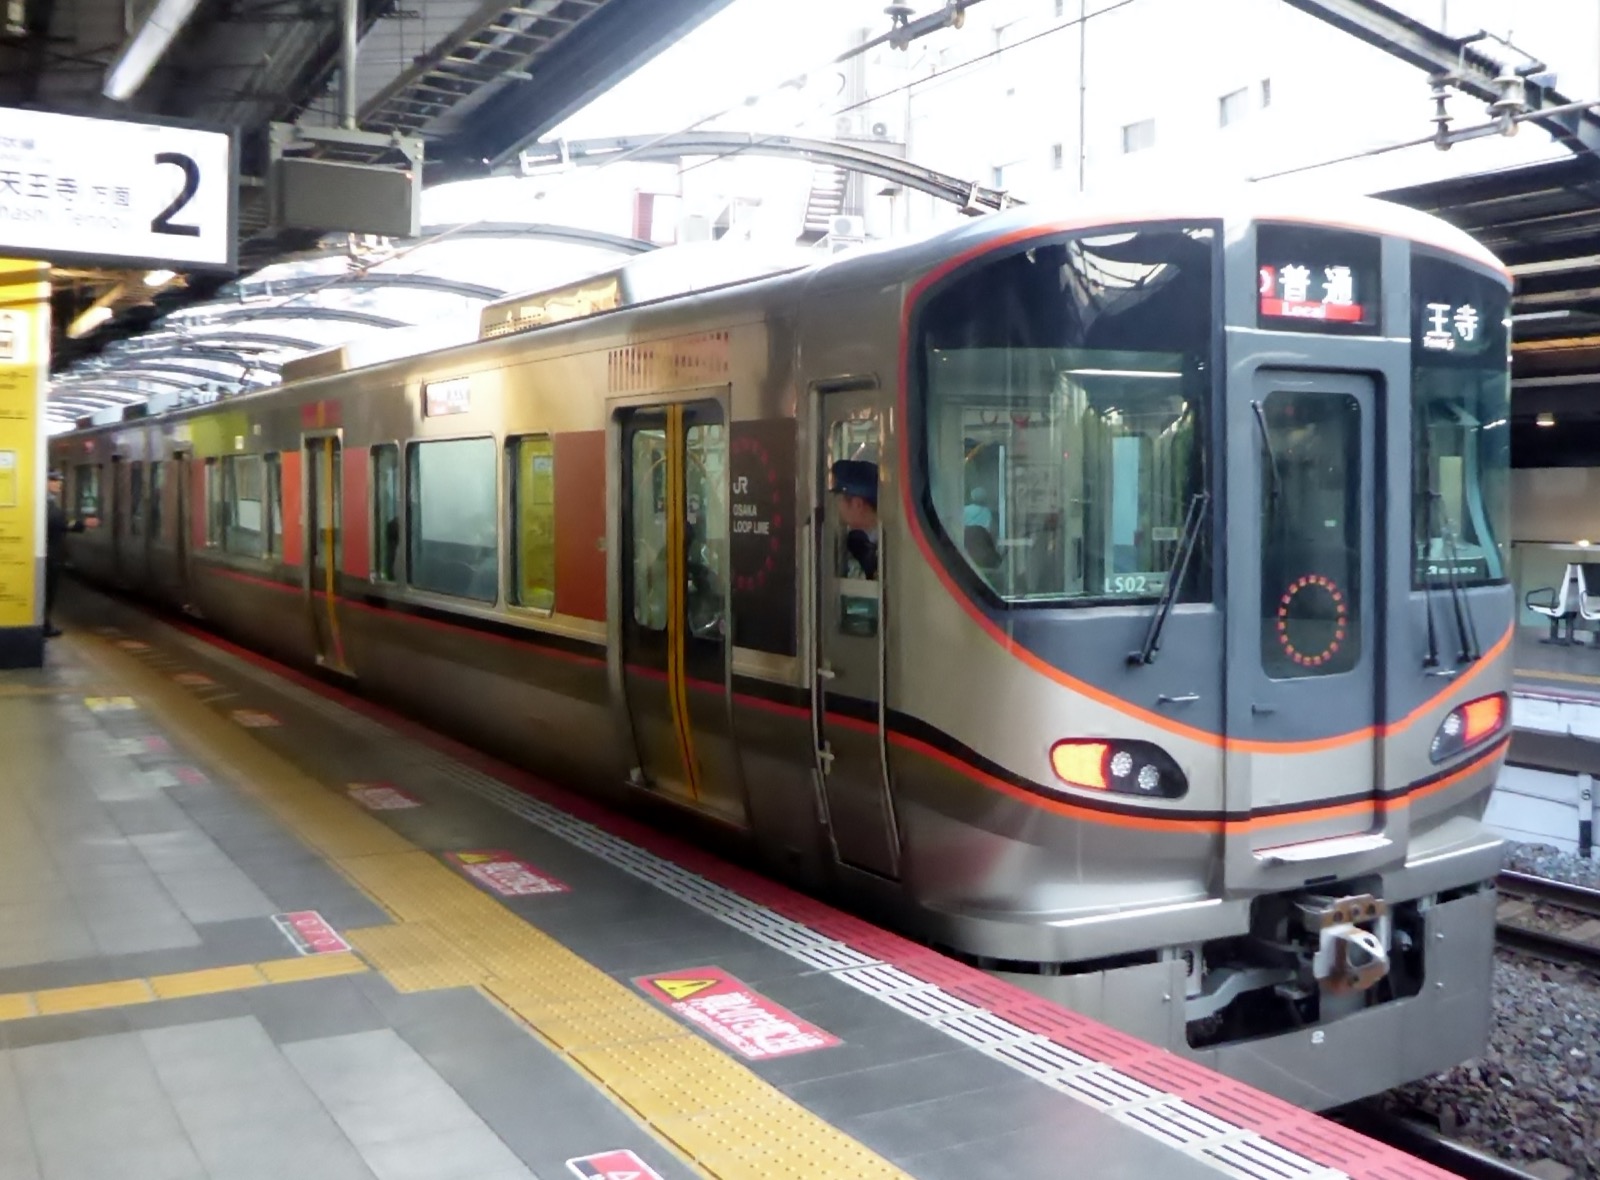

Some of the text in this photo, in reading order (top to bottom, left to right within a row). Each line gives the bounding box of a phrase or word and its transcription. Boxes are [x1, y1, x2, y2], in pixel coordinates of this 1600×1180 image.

[151, 152, 201, 237] 2
[1278, 264, 1353, 305] 普通
[733, 476, 748, 494] JR
[733, 521, 752, 533] LOOP
[1105, 576, 1146, 592] LS02
